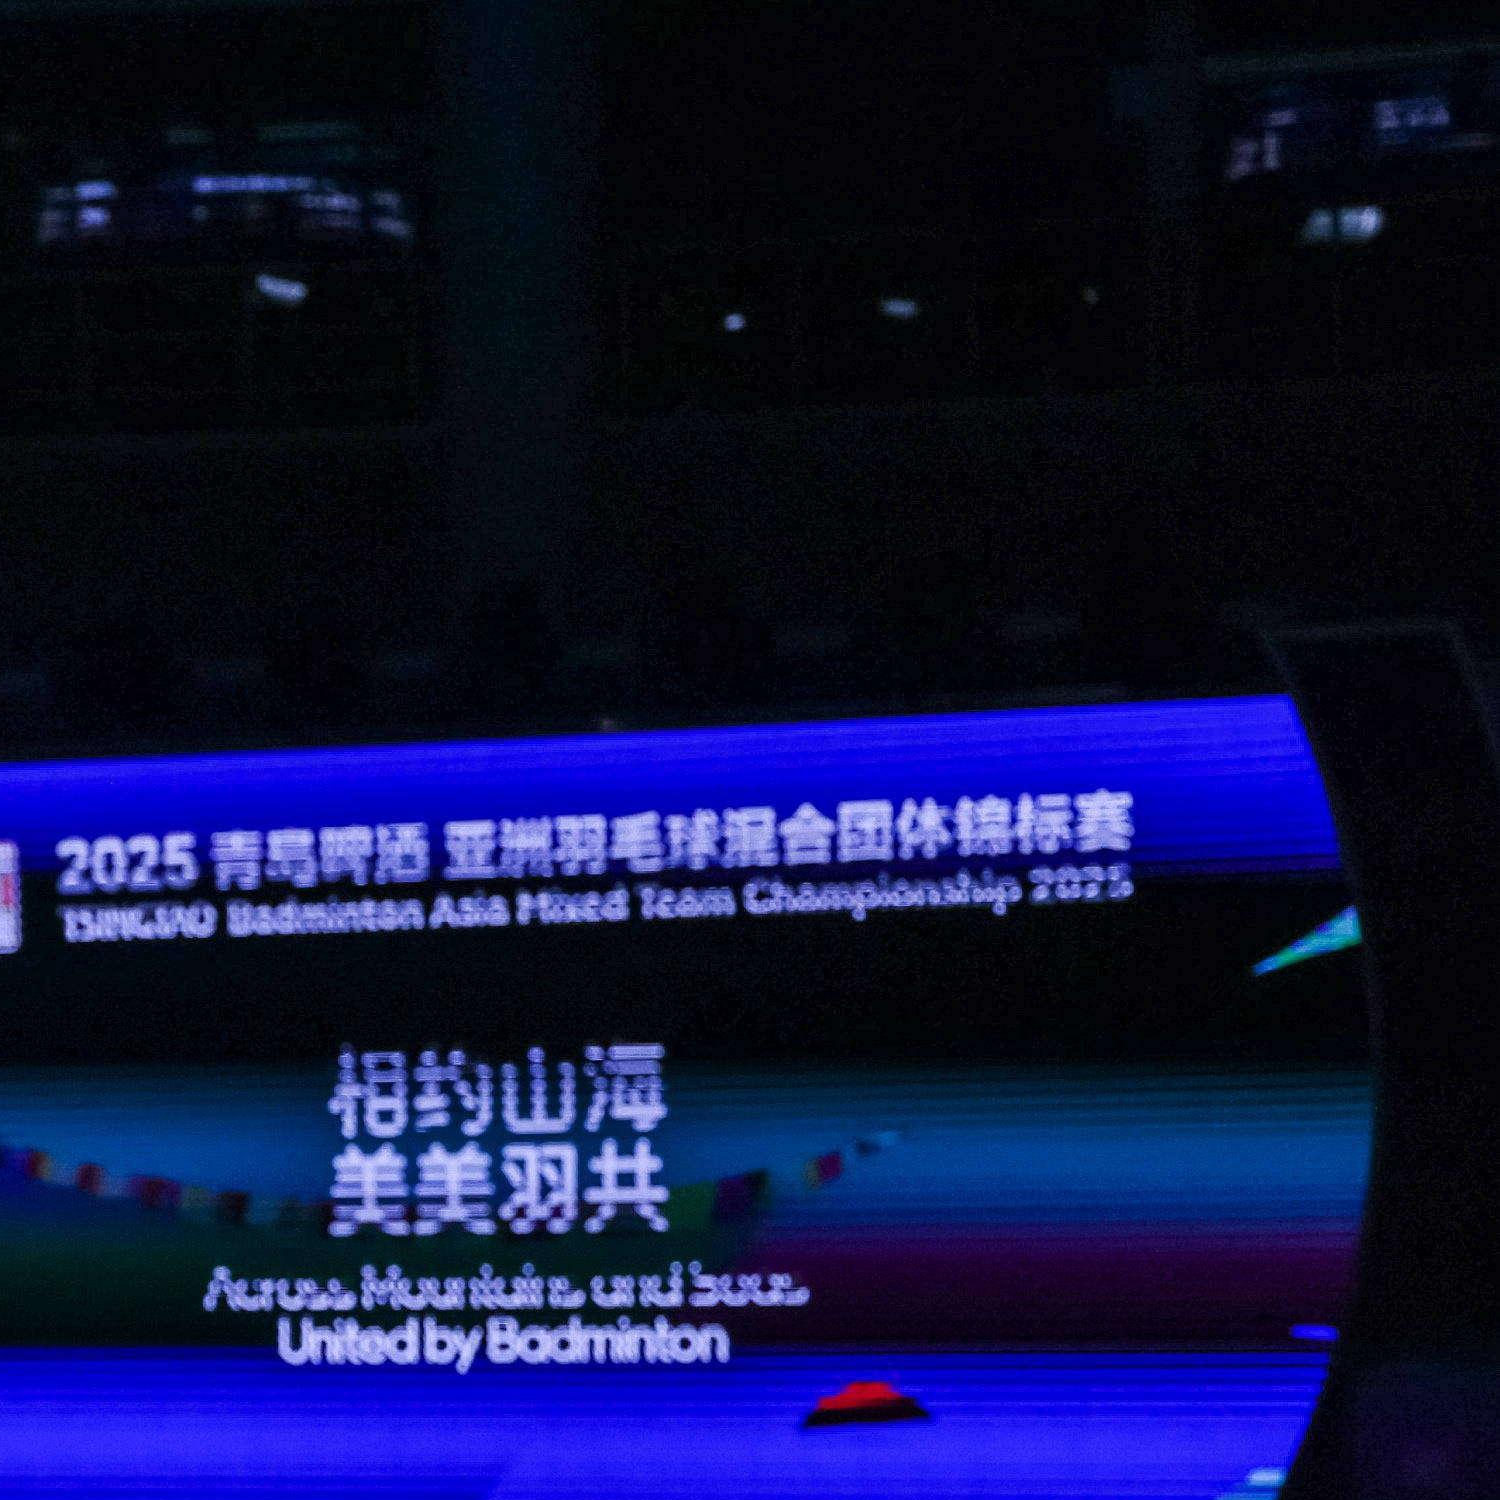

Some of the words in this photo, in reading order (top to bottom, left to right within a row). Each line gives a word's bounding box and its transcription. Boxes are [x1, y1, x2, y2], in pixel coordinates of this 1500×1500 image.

[55, 831, 199, 894] 2025
[327, 1043, 668, 1139] 相约山海
[327, 1138, 670, 1237] 美美羽共
[276, 1314, 420, 1366] United
[422, 1314, 485, 1375] by
[486, 1313, 732, 1365] Badminton
